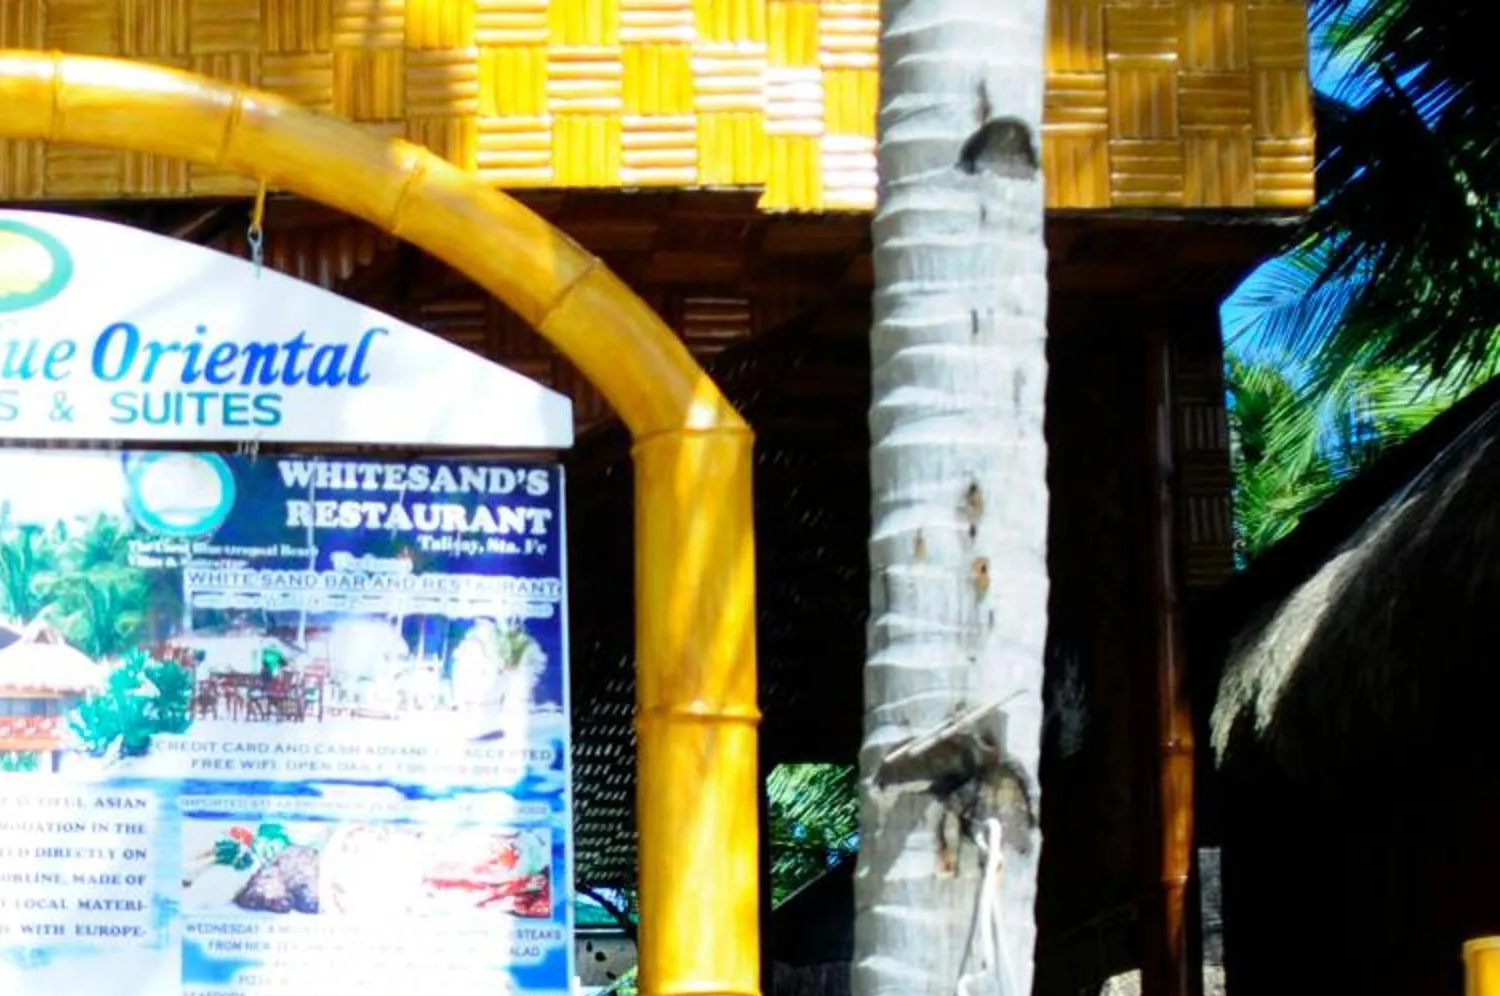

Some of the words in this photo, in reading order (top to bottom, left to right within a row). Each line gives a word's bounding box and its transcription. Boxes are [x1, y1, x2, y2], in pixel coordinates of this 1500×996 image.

[91, 321, 389, 387] Oriental
[49, 390, 76, 423] &
[111, 391, 283, 427] SUITES
[278, 460, 550, 496] WHITESAND'S
[286, 500, 551, 535] RESTAURANT
[188, 573, 251, 586] WHITE
[261, 573, 318, 587] SAND
[325, 575, 368, 588] BAR
[373, 575, 414, 589] AND
[155, 740, 218, 754] CREDIT
[222, 741, 269, 754] CARD
[274, 742, 310, 755] AND
[314, 742, 361, 756] CASH
[365, 744, 444, 757] ADVAN
[190, 758, 235, 769] FREE
[286, 760, 331, 771] OPEN
[94, 798, 147, 810] ASIAN
[91, 823, 110, 833] IN
[115, 823, 147, 834] THE
[34, 847, 116, 859] DIRECTLY
[122, 848, 147, 860] ON
[72, 874, 122, 885] MADE
[125, 874, 147, 886] OF
[15, 899, 69, 910] LOCAL
[77, 899, 148, 912] MATERI-
[20, 924, 65, 936] WITH
[74, 925, 147, 938] EUROPE-
[186, 923, 260, 934] WEDNESDAY
[208, 940, 243, 950] FROM
[505, 946, 541, 957] ALAD
